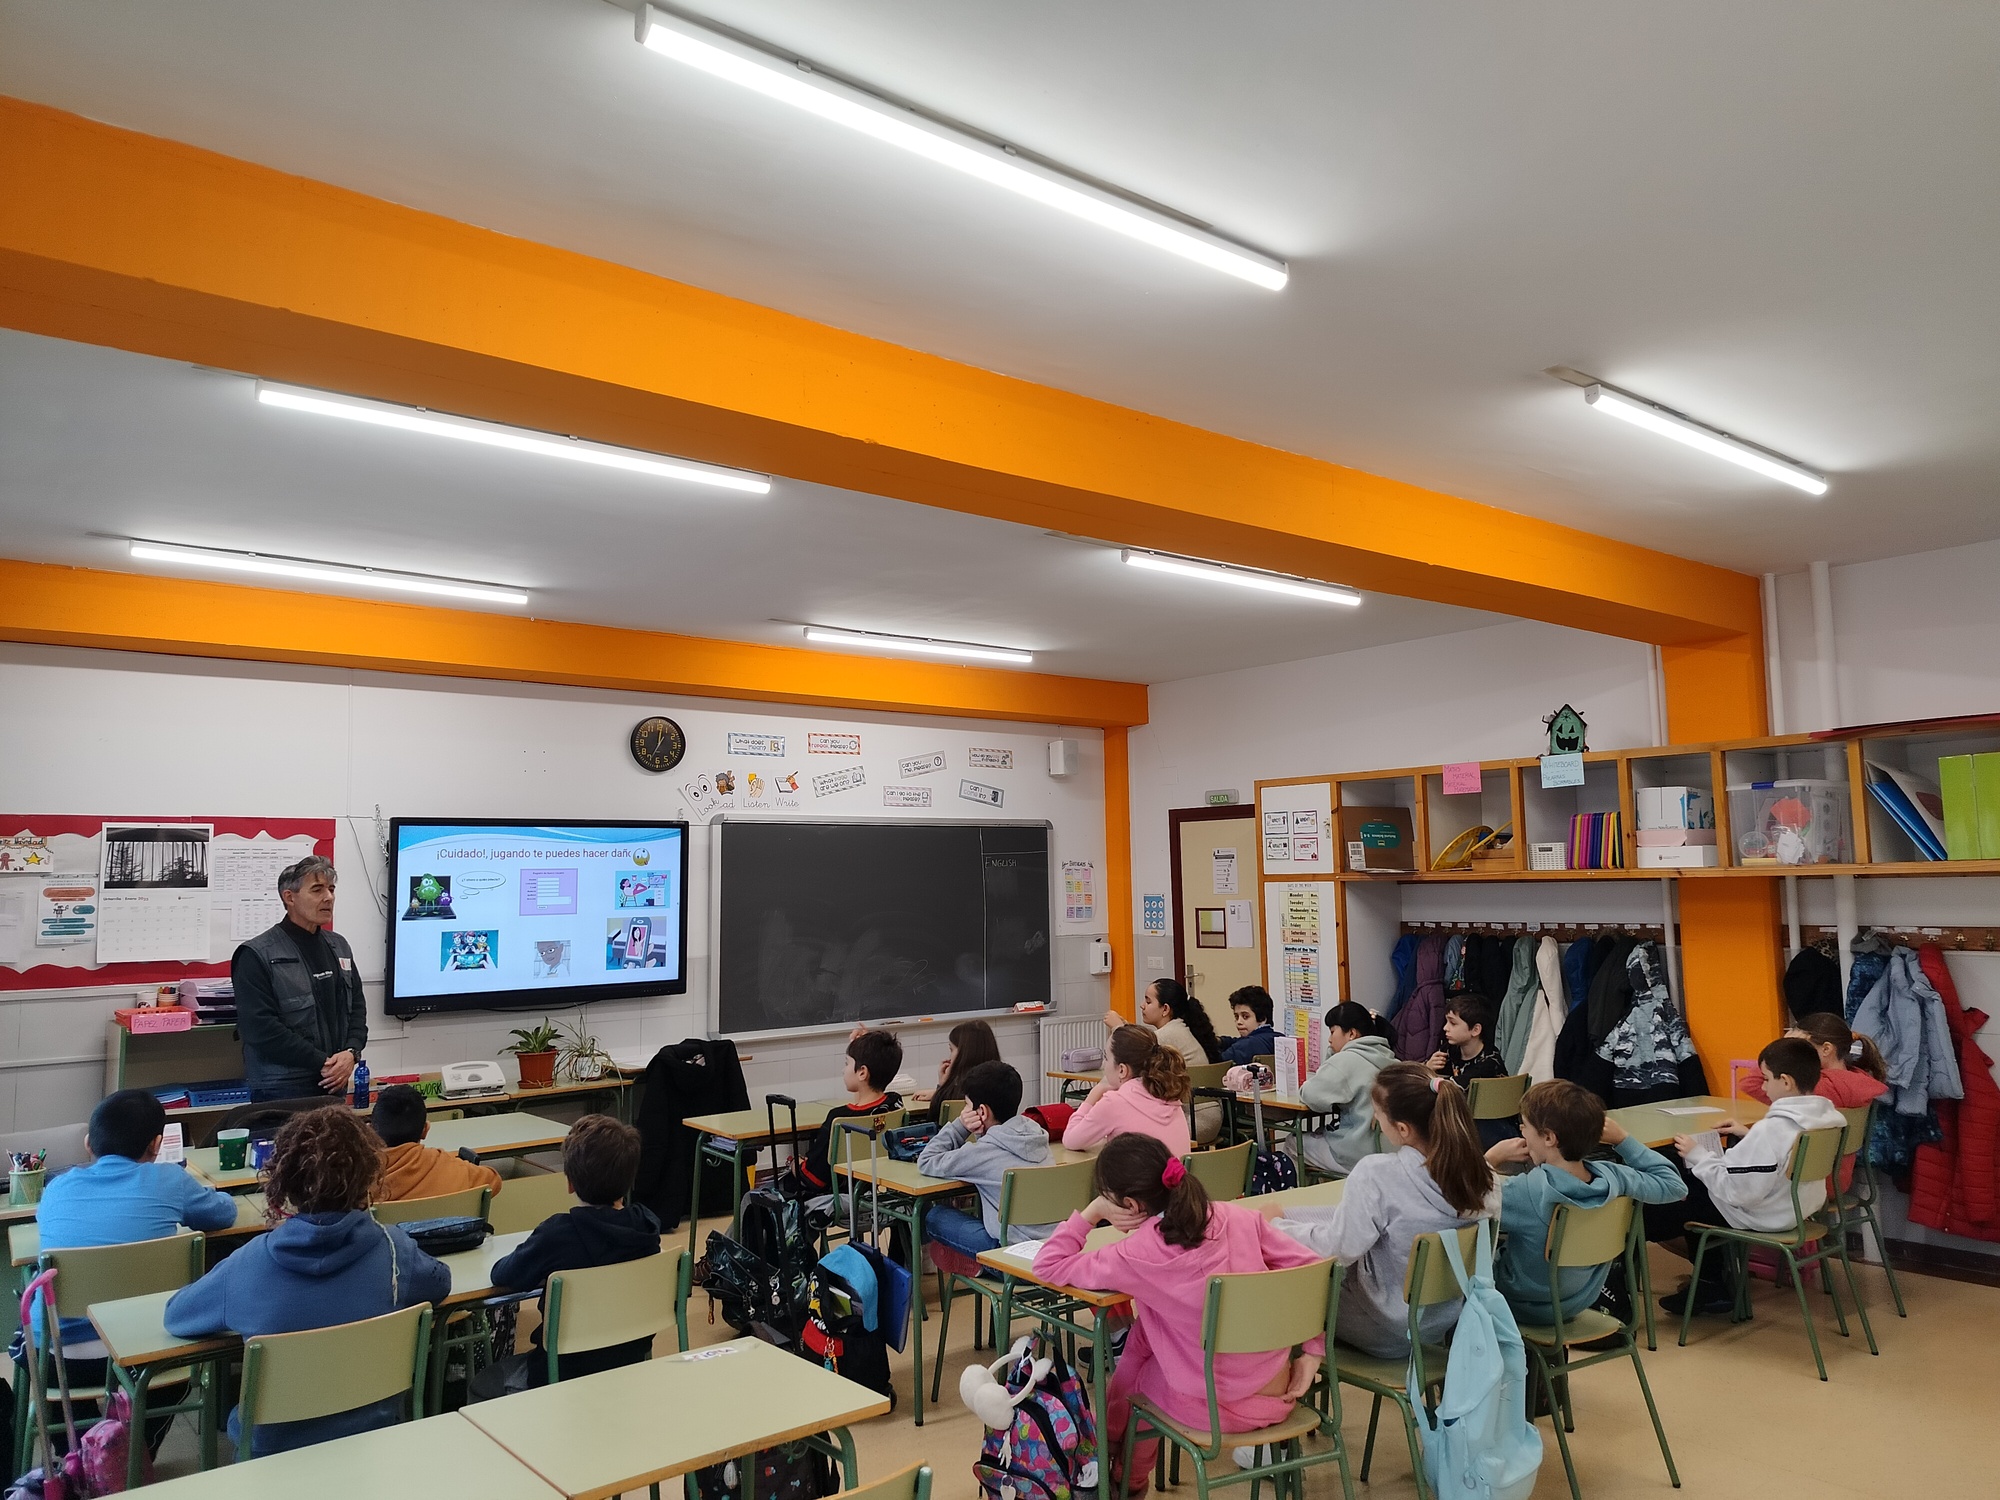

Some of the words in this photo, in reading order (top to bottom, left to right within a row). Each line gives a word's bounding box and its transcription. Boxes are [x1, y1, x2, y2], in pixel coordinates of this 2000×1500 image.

[1542, 760, 1579, 768] WHITEBOARD
[698, 798, 719, 816] Look
[743, 798, 770, 808] Listen
[776, 797, 799, 807] Write
[436, 849, 488, 860] ¡Cuidado!,
[490, 849, 530, 860] jugando
[534, 849, 543, 858] te
[546, 849, 580, 860] puedes
[583, 849, 608, 858] hacer
[985, 856, 1016, 868] ENGLISH
[134, 1018, 158, 1028] PAPEL
[162, 1018, 186, 1027] PAPER
[413, 1082, 442, 1095] EWORK
